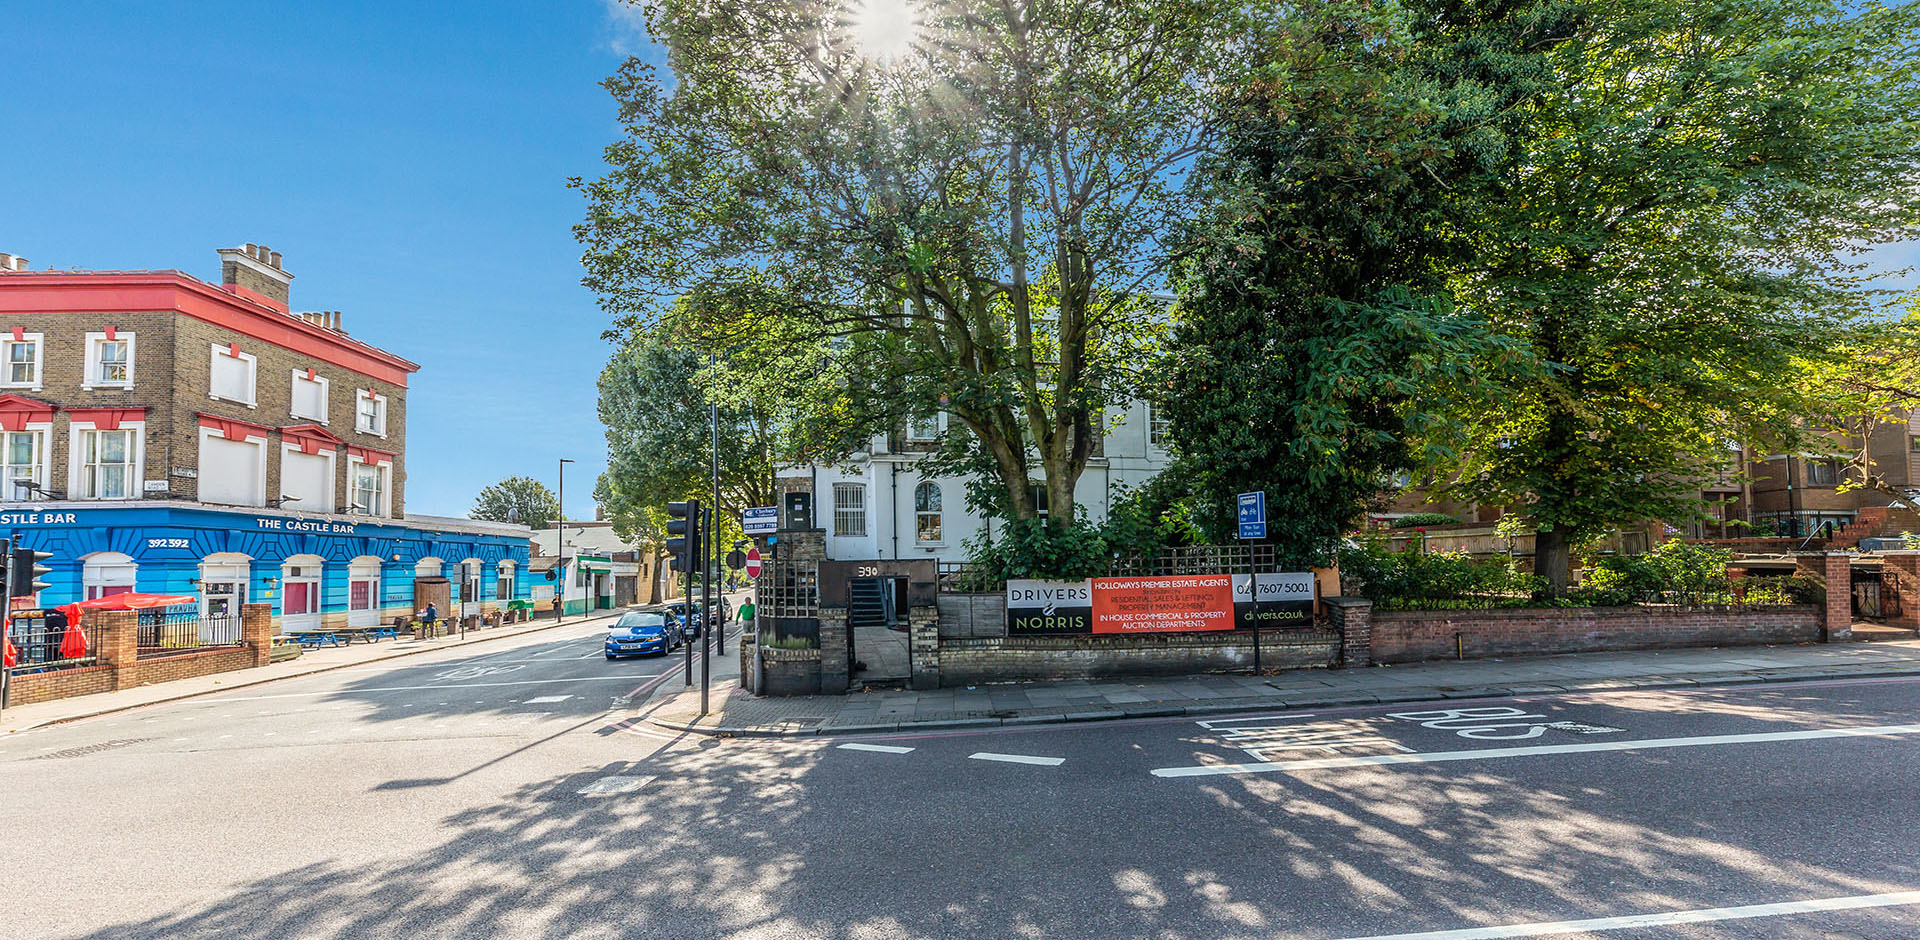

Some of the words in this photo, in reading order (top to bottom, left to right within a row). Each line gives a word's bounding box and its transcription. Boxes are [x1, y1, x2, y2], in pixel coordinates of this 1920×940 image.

[44, 513, 77, 524] BAR
[256, 518, 282, 529] THE
[285, 520, 330, 532] CASTLE
[333, 524, 355, 534] BAR
[148, 538, 168, 548] 392
[168, 538, 189, 548] 392
[858, 566, 878, 576] 390
[1095, 582, 1140, 590] HOLLOWAYS
[1172, 580, 1197, 588] ESTATE
[1198, 579, 1229, 587] AGENTS
[1236, 584, 1252, 594] 02
[1258, 584, 1283, 593] 7607
[1284, 583, 1309, 592] 5001
[1011, 588, 1088, 600] DRIVERS
[1182, 593, 1214, 601] LETTINGS
[1043, 601, 1056, 616] &
[1110, 613, 1133, 621] HOUSE
[1135, 612, 1182, 620] COMMERCIAL
[1191, 610, 1226, 619] PROPERTY
[1016, 616, 1084, 629] NORRIS
[1122, 620, 1155, 629] AUCTION
[1157, 619, 1206, 627] DEPARTMENTS
[1384, 706, 1547, 739] BUS
